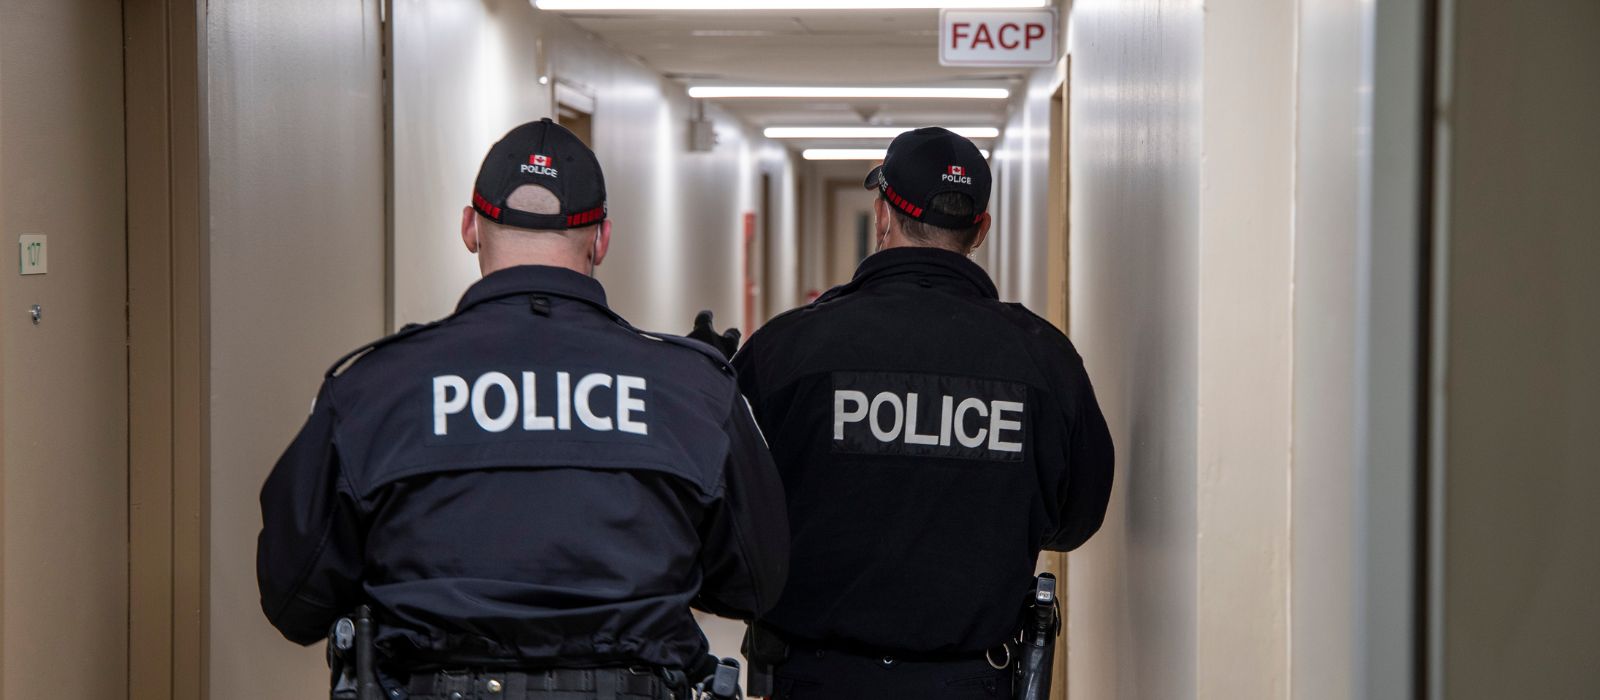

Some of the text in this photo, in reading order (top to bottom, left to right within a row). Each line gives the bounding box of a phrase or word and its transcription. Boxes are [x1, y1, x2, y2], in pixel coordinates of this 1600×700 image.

[952, 23, 1045, 49] FACP
[521, 164, 558, 178] POLICE
[941, 173, 972, 185] POLICE
[433, 371, 648, 436] POLICE
[835, 390, 1023, 452] POLICE
